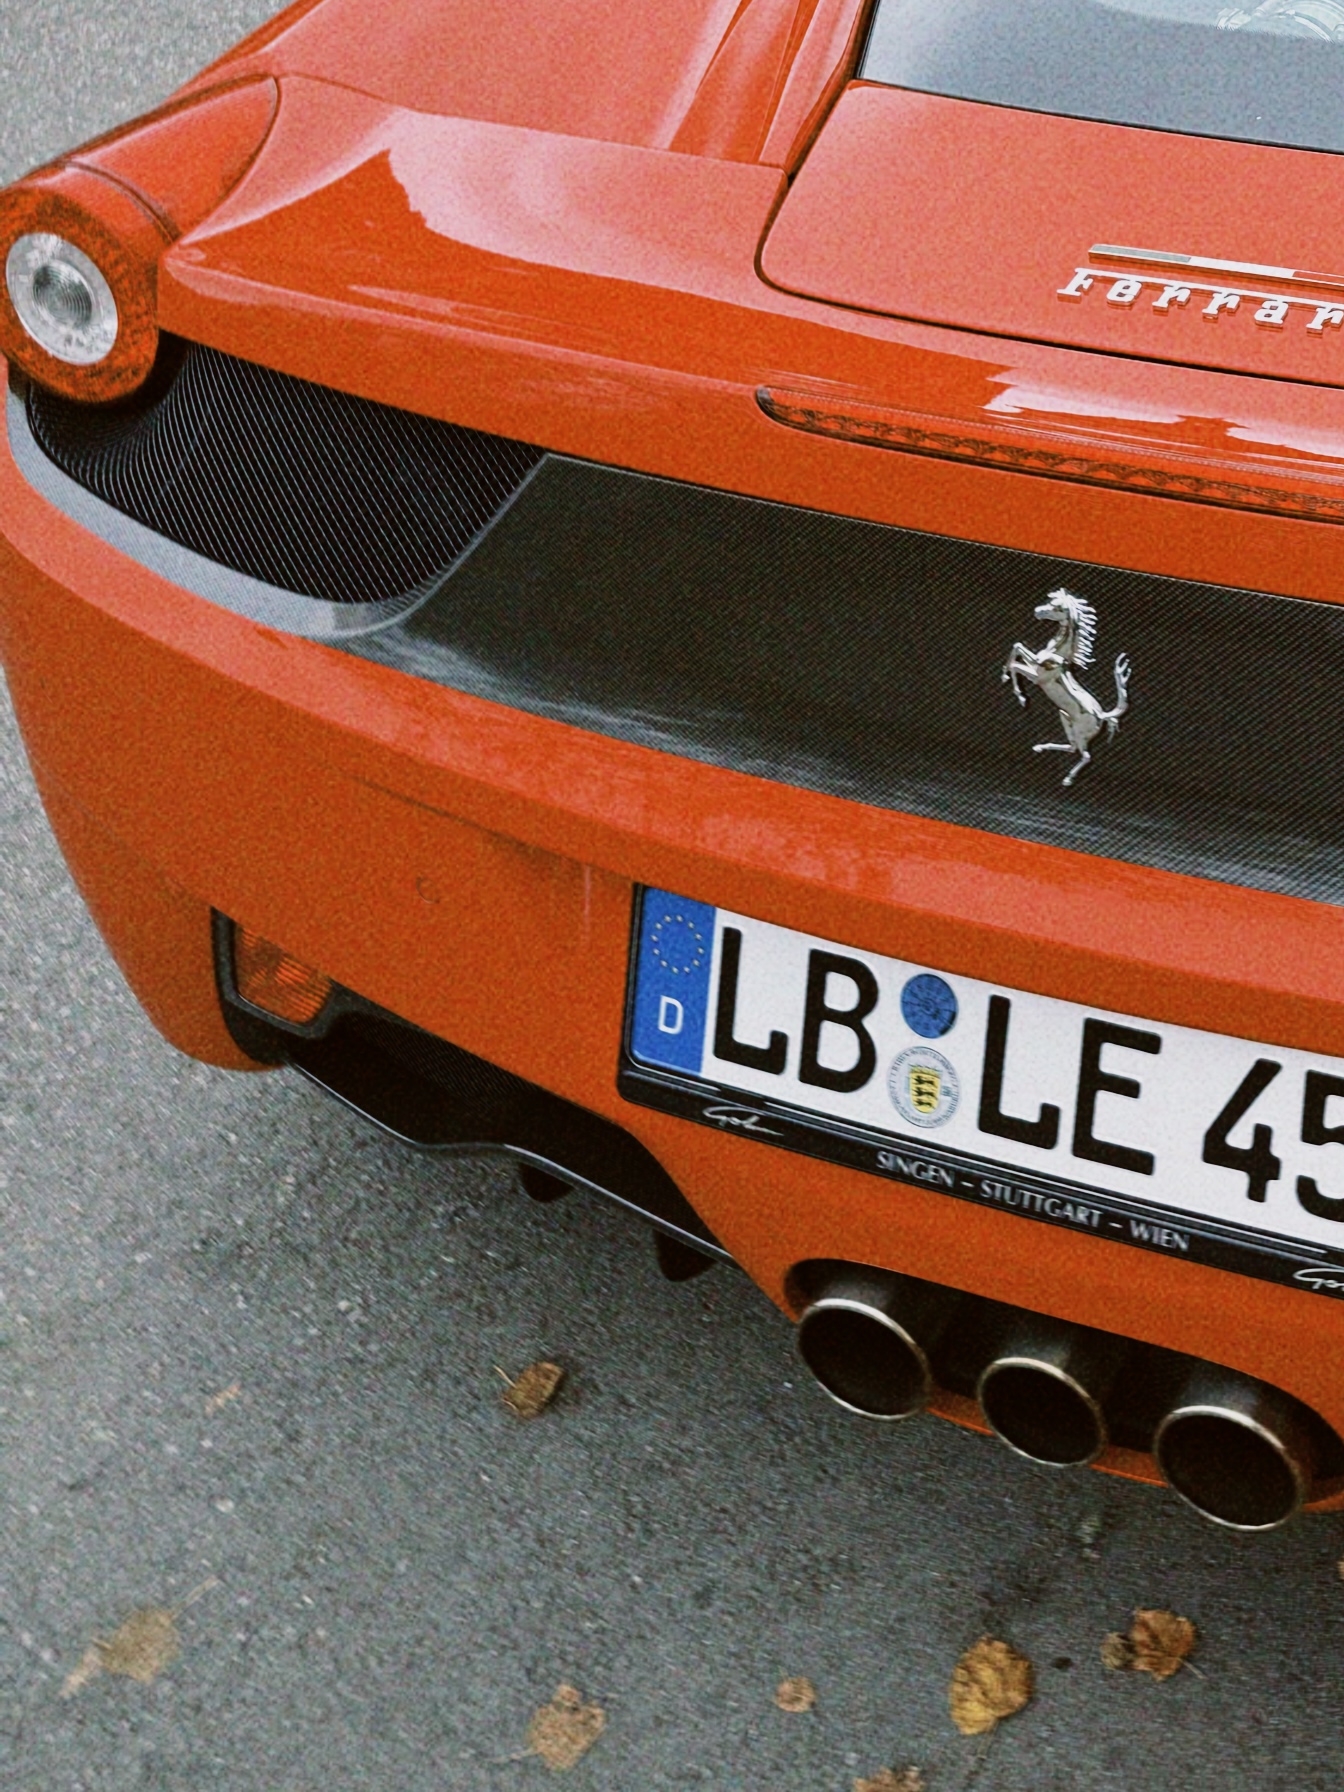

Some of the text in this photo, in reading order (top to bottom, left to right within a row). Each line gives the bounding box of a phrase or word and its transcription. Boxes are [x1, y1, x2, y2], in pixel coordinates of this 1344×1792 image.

[657, 995, 684, 1035] D
[713, 925, 880, 1094] LB
[977, 993, 1163, 1177] LE
[876, 1150, 956, 1188] SINGEN
[979, 1179, 1105, 1228] STUTTGART
[1129, 1219, 1190, 1252] WIEN
